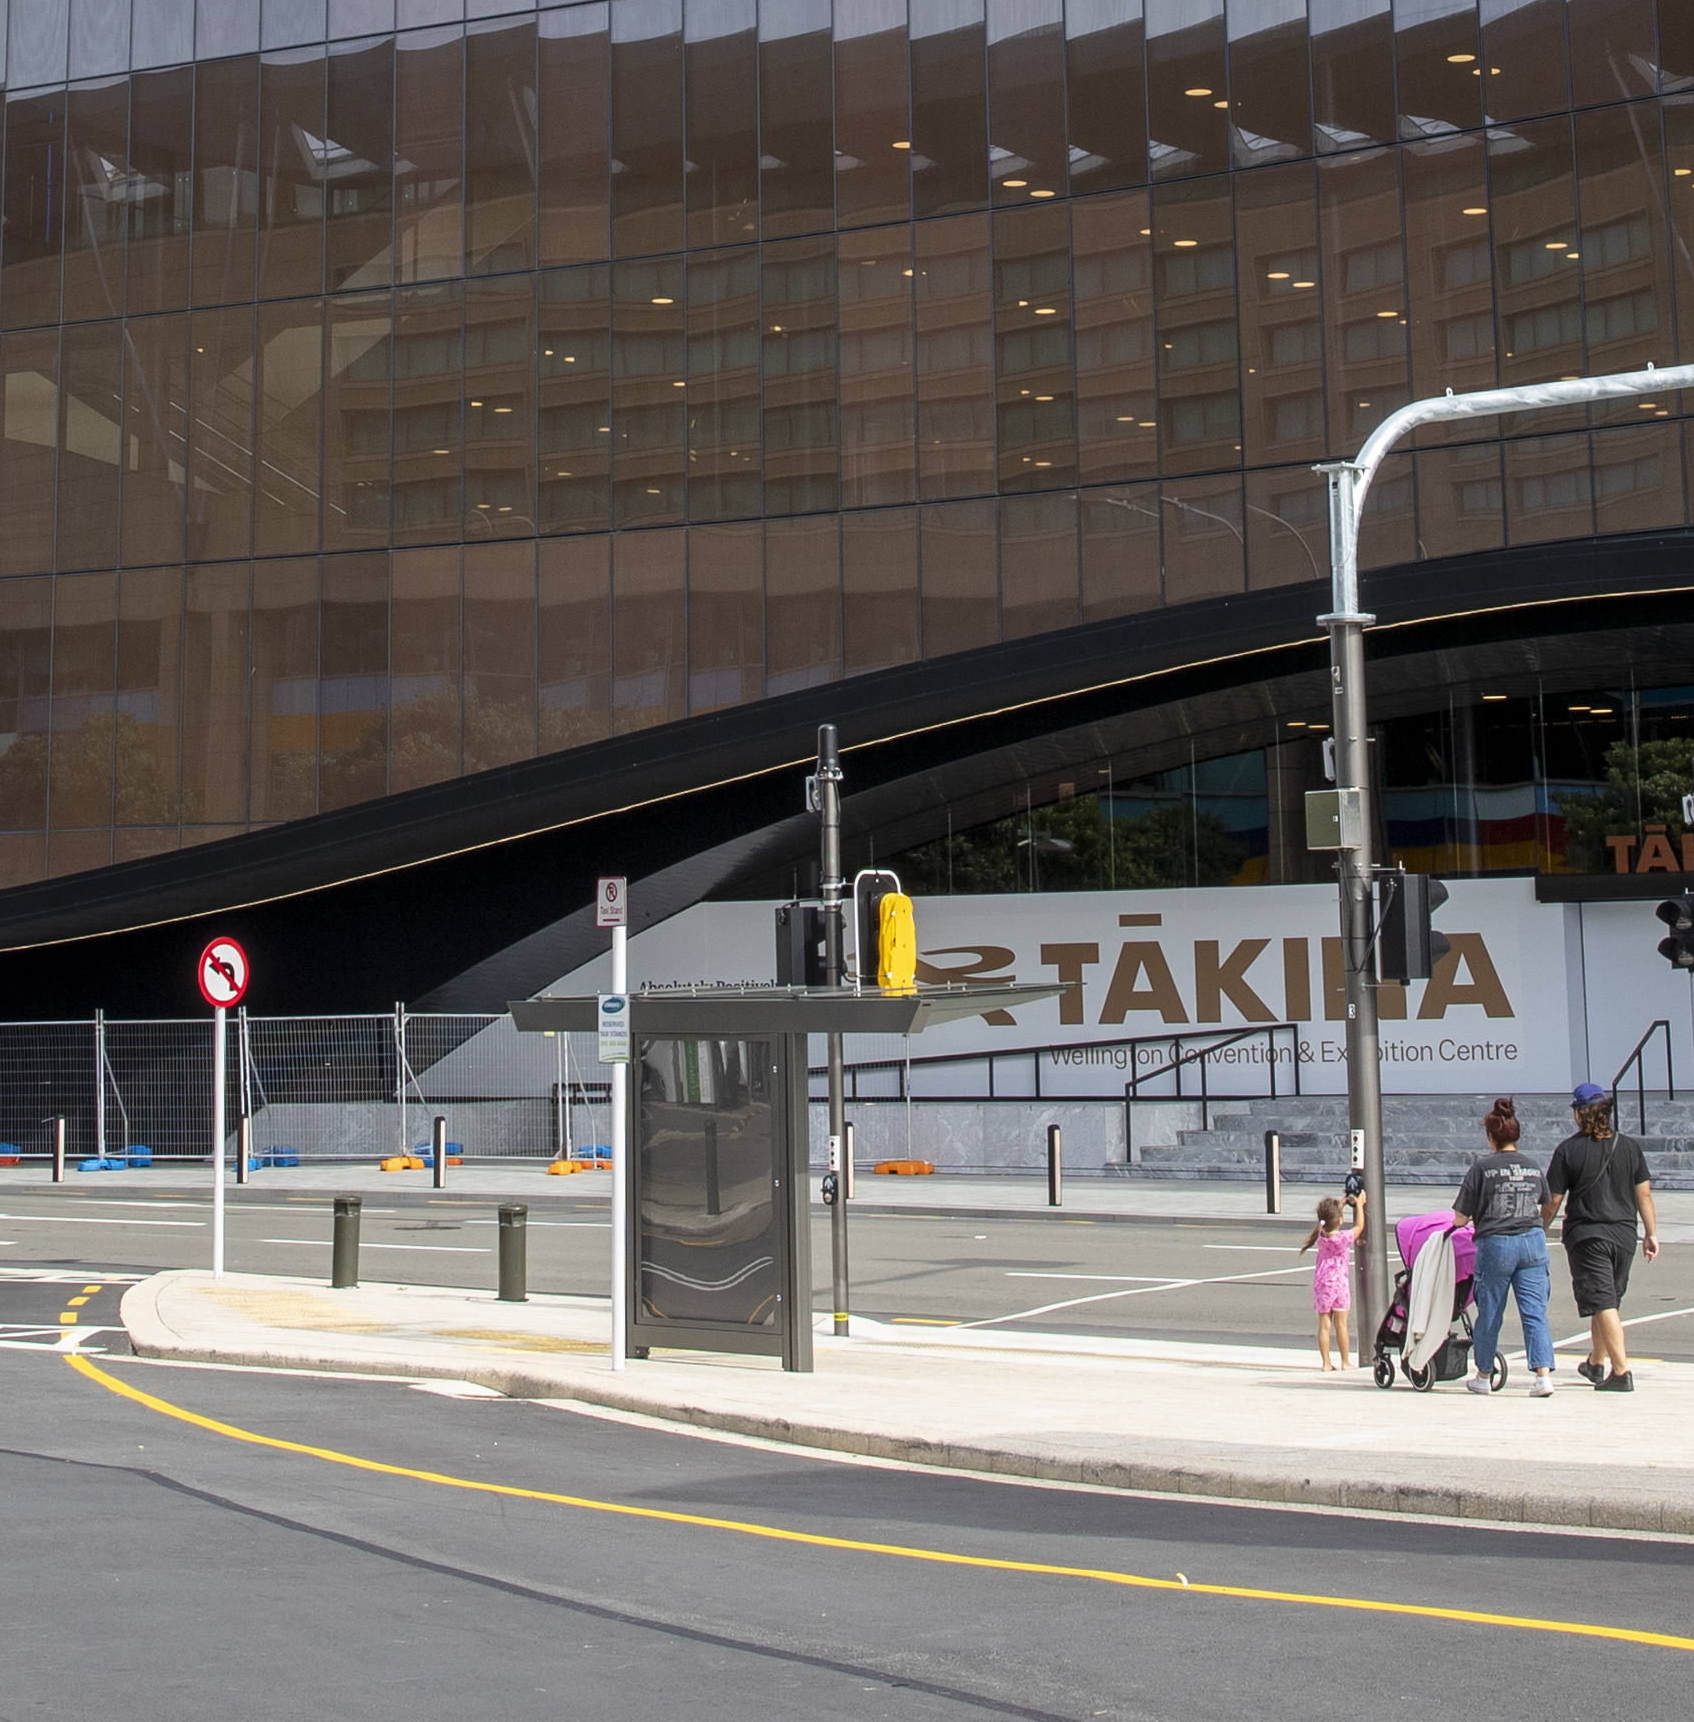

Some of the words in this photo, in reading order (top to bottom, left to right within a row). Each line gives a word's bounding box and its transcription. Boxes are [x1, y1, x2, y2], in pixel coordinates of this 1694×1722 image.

[1051, 1045, 1163, 1070] Wellington
[1168, 1041, 1292, 1064] Convention
[1297, 1040, 1316, 1063] &
[1321, 1040, 1433, 1063] Exition
[1439, 1038, 1518, 1061] Centre
[1485, 1169, 1498, 1178] UP
[1500, 1168, 1511, 1177] IN
